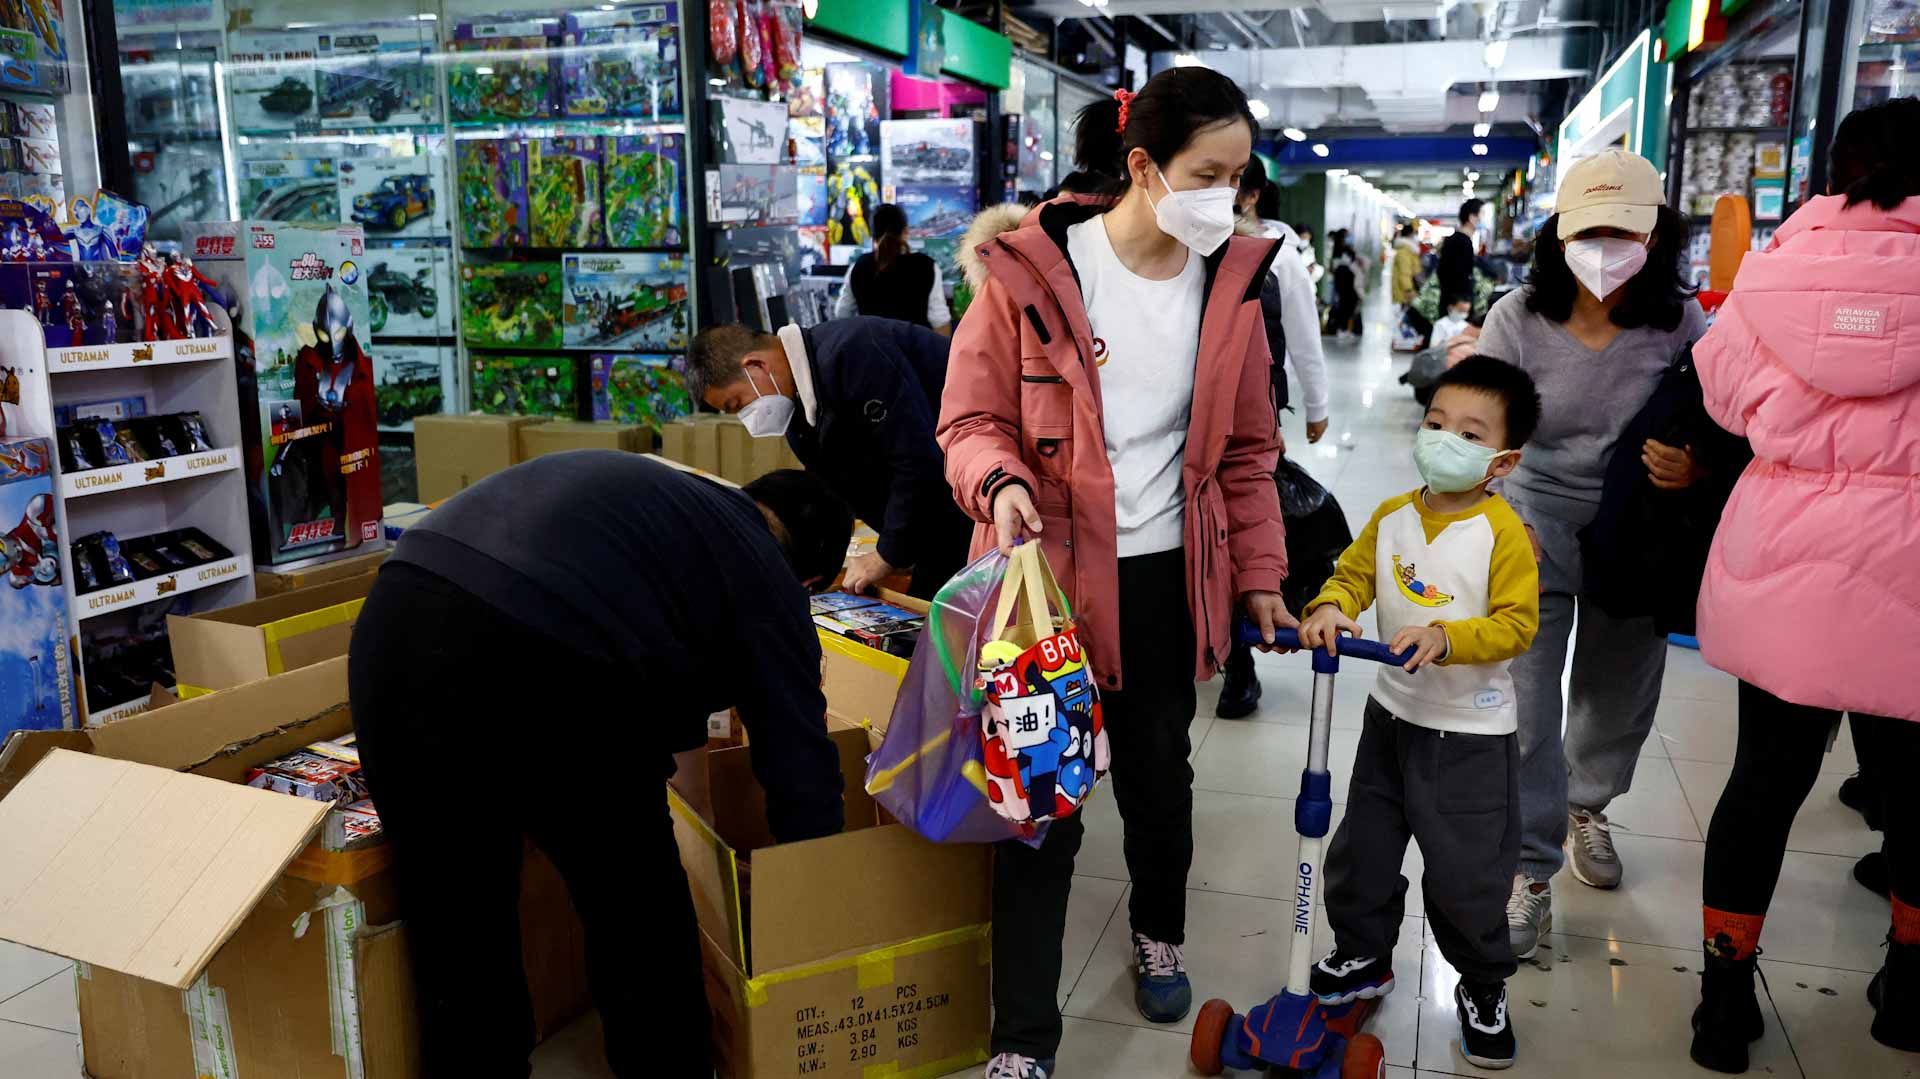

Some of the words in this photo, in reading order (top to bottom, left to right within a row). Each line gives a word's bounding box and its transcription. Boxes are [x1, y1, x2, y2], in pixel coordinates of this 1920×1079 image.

[1833, 323, 1877, 332] COOLEST
[1836, 315, 1877, 325] NEWEST
[60, 350, 109, 364] ULTRAMAN
[176, 343, 217, 356] ULTRAMAN
[75, 472, 123, 489] ULTRAMAN
[187, 454, 228, 470] ULTRAMAN
[88, 589, 135, 609] ULTRAMAN
[198, 563, 238, 581] ULTRAMAN
[996, 674, 1014, 694] M
[1294, 862, 1312, 935] OPHANIE
[851, 996, 864, 1011] 12
[896, 984, 917, 1001] PCS
[849, 1028, 876, 1044] 3.84
[897, 1017, 918, 1034] KGS
[850, 1045, 877, 1061] 2.90
[898, 1033, 919, 1049] KGS
